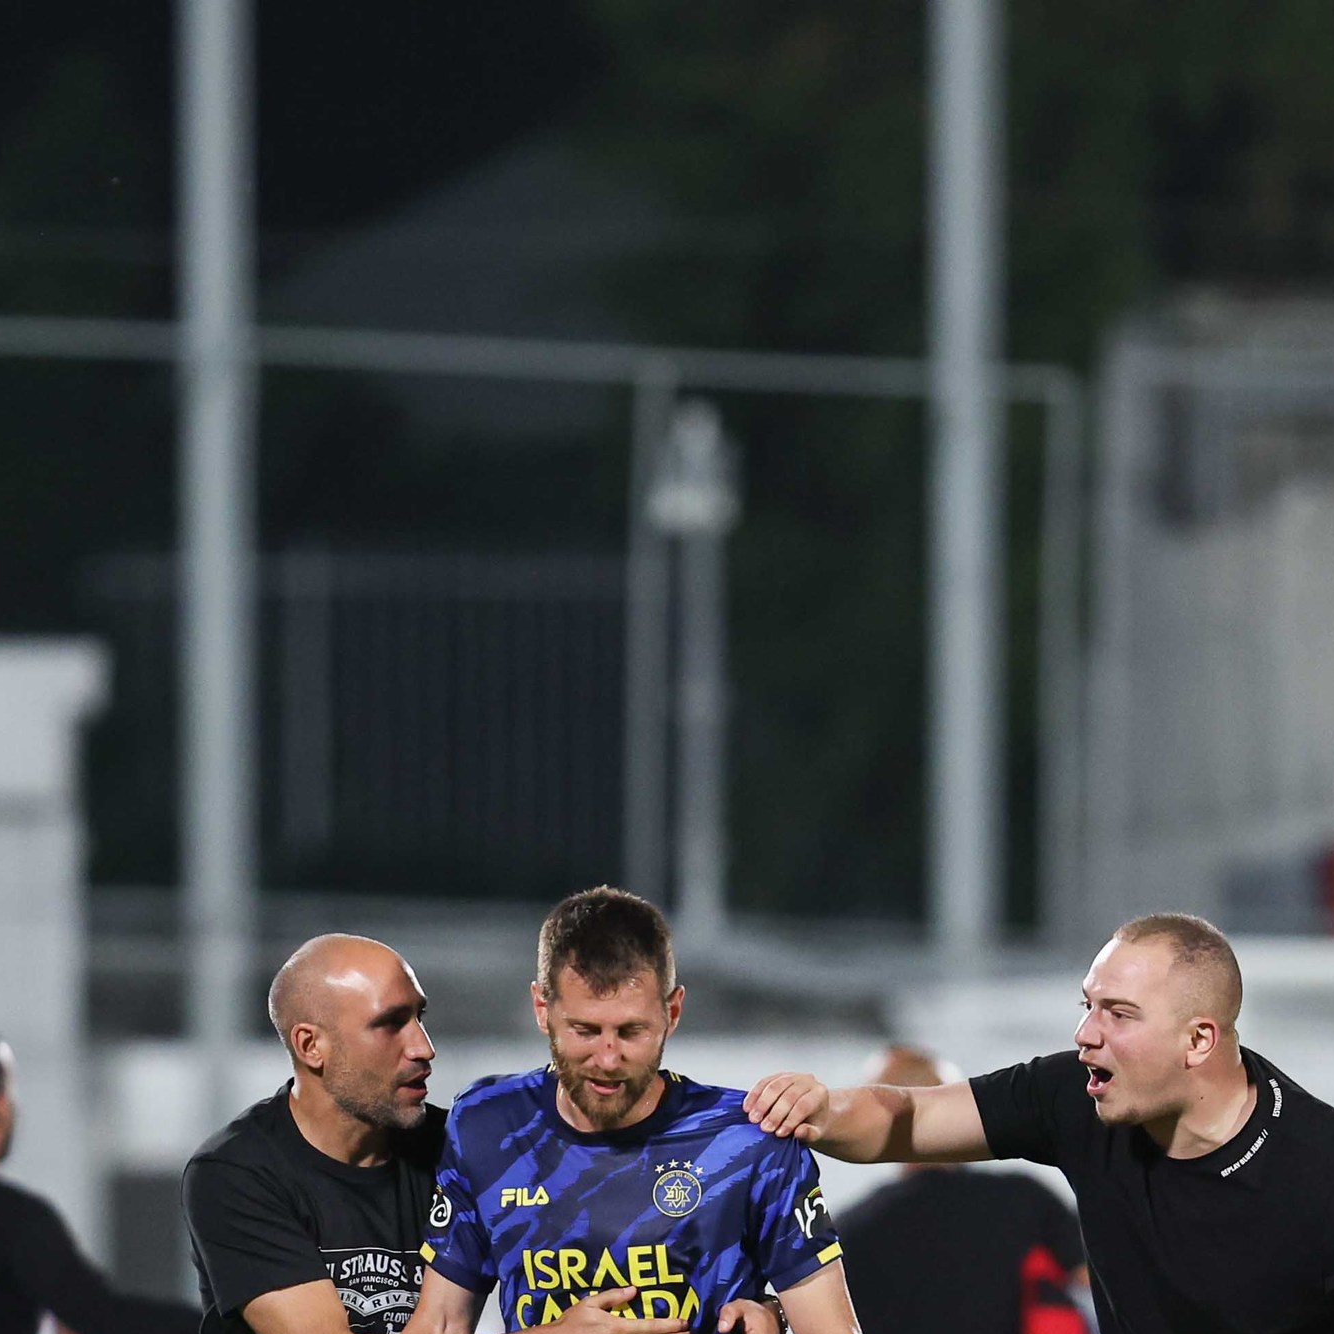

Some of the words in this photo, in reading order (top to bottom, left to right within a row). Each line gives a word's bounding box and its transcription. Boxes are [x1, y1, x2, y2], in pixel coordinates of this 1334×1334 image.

[1220, 1161, 1241, 1178] REPLAY
[1239, 1150, 1254, 1166] BLUE
[1250, 1135, 1265, 1154] JEANS
[500, 1186, 550, 1208] FILA
[348, 1277, 360, 1287] SAN
[521, 1244, 684, 1291] ISRAEL
[340, 1292, 366, 1311] INAL
[372, 1294, 416, 1309] RIVE
[516, 1286, 700, 1331] CADA
